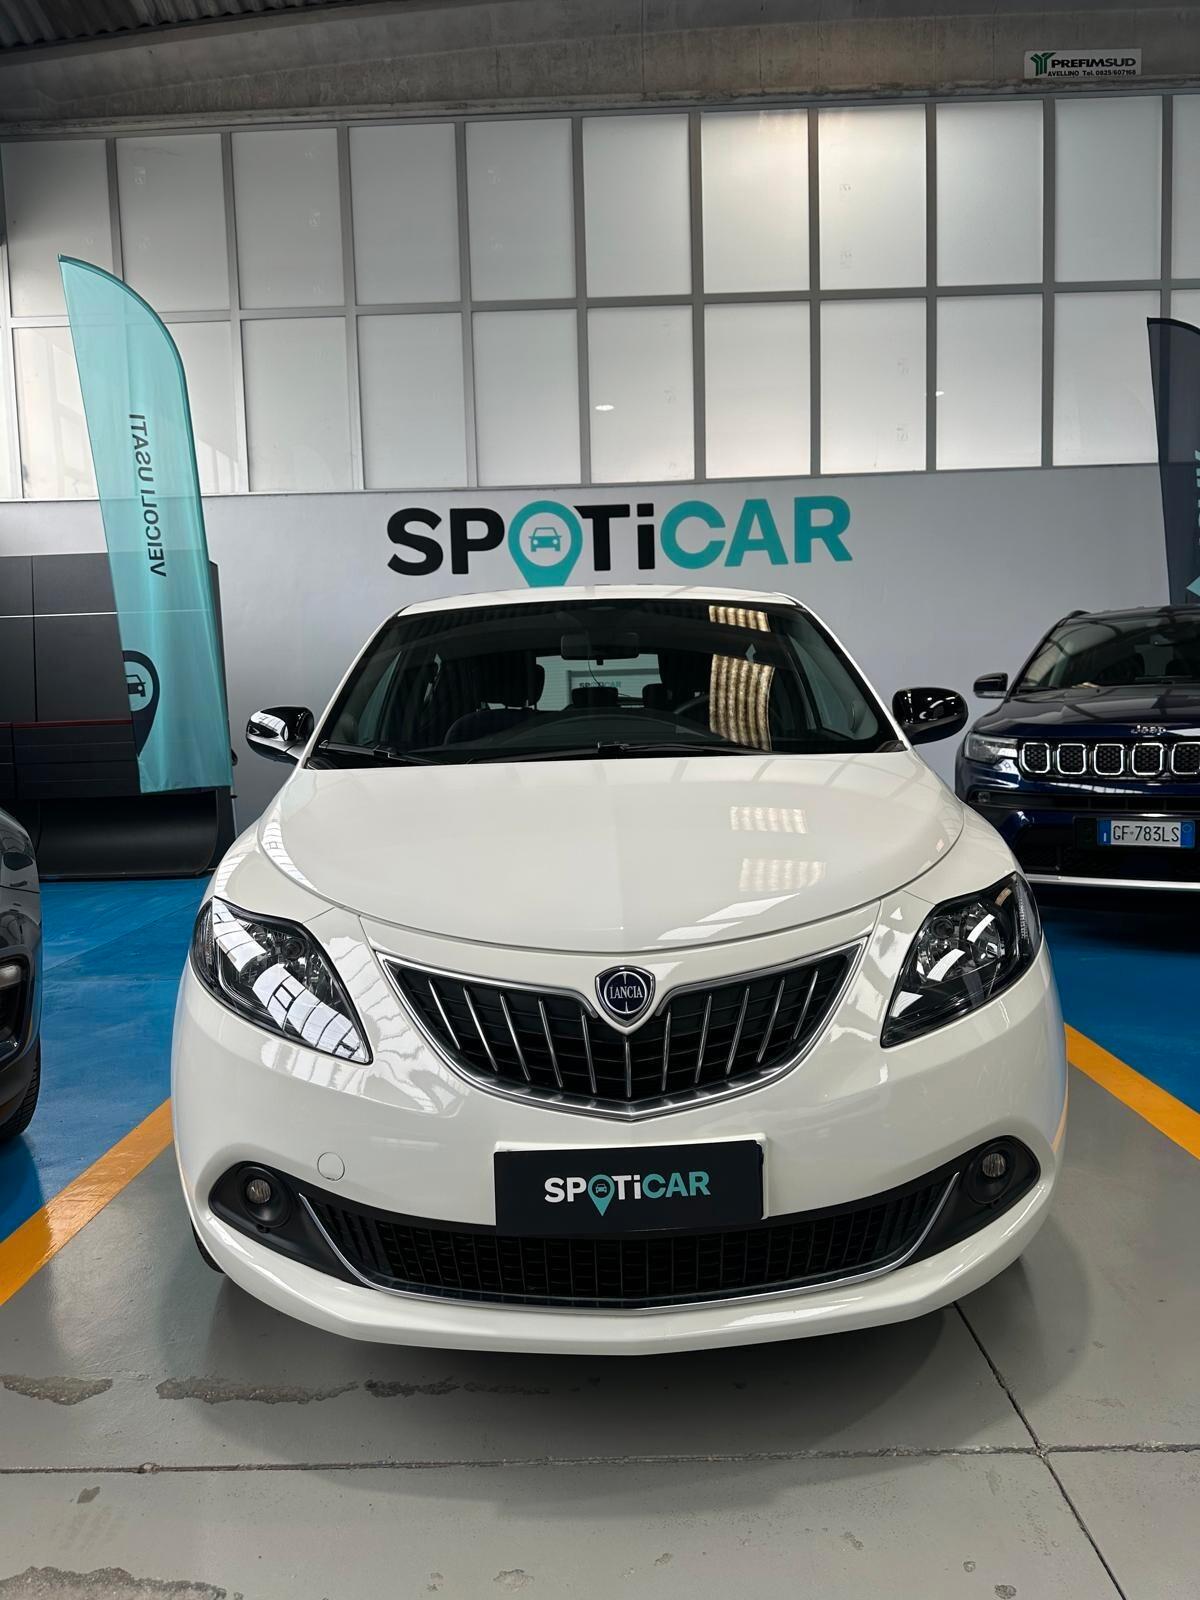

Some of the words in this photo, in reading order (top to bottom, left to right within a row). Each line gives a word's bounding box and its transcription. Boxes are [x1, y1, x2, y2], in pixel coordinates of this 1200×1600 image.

[1051, 58, 1136, 69] PREFIMSUD
[1130, 724, 1166, 736] Jeep
[609, 985, 643, 999] LANCIA
